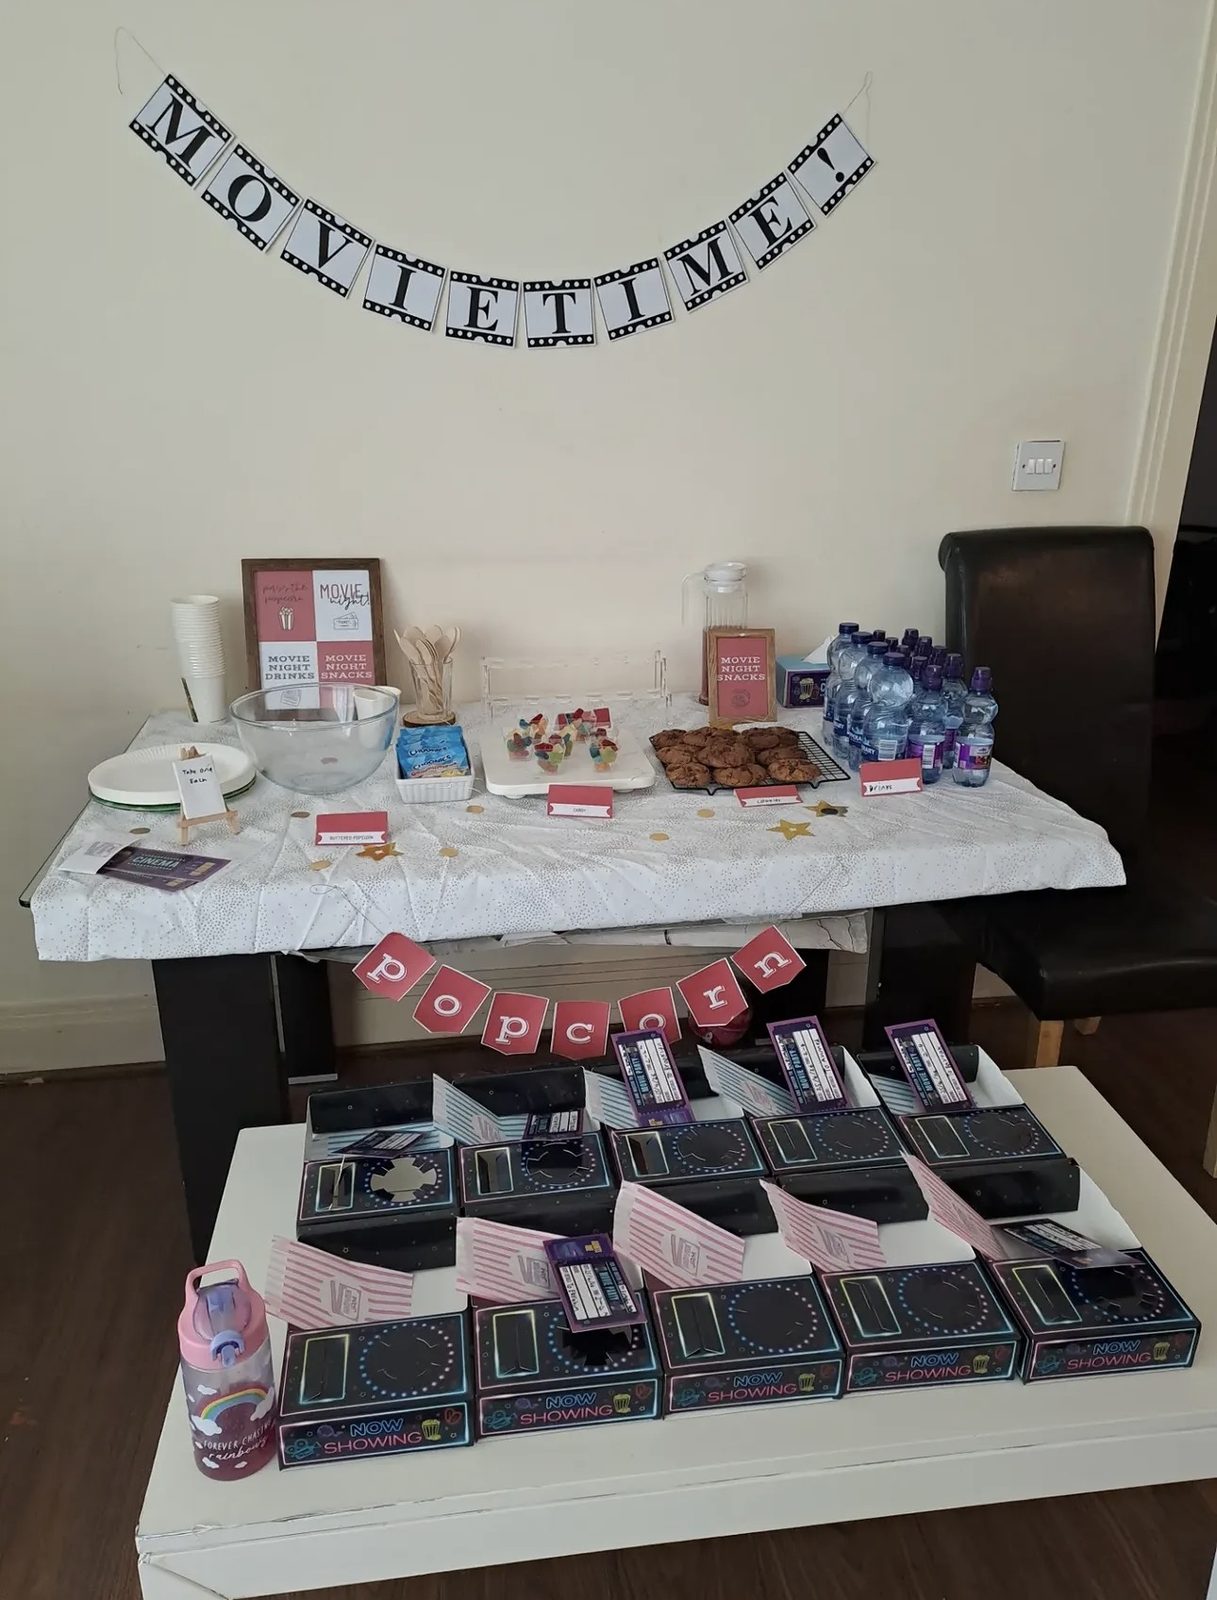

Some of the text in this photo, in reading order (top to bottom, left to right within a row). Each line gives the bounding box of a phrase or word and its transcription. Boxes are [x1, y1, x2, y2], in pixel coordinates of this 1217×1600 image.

[320, 584, 362, 599] MOVIE
[268, 655, 310, 663] MOVIE
[325, 654, 366, 662] MOVIE
[720, 656, 761, 664] MOVIE
[326, 663, 367, 671] NIGHT
[721, 665, 761, 673] NIGHT
[265, 672, 315, 680] DRINKS
[321, 671, 372, 679] SNACKS
[717, 673, 766, 681] SNACKS
[133, 856, 179, 868] CINEMA
[1093, 1339, 1141, 1355] NOW
[910, 1352, 959, 1368] NOW
[1067, 1352, 1151, 1370] SHOWING
[733, 1371, 784, 1387] NOW
[884, 1365, 971, 1383] SHOWING
[708, 1383, 797, 1402] SHOWING
[546, 1392, 597, 1409] NOW
[520, 1404, 613, 1425] SHOWING
[351, 1418, 404, 1437] NOW
[203, 1440, 239, 1451] FOREVER
[324, 1432, 422, 1454] SHOWING
